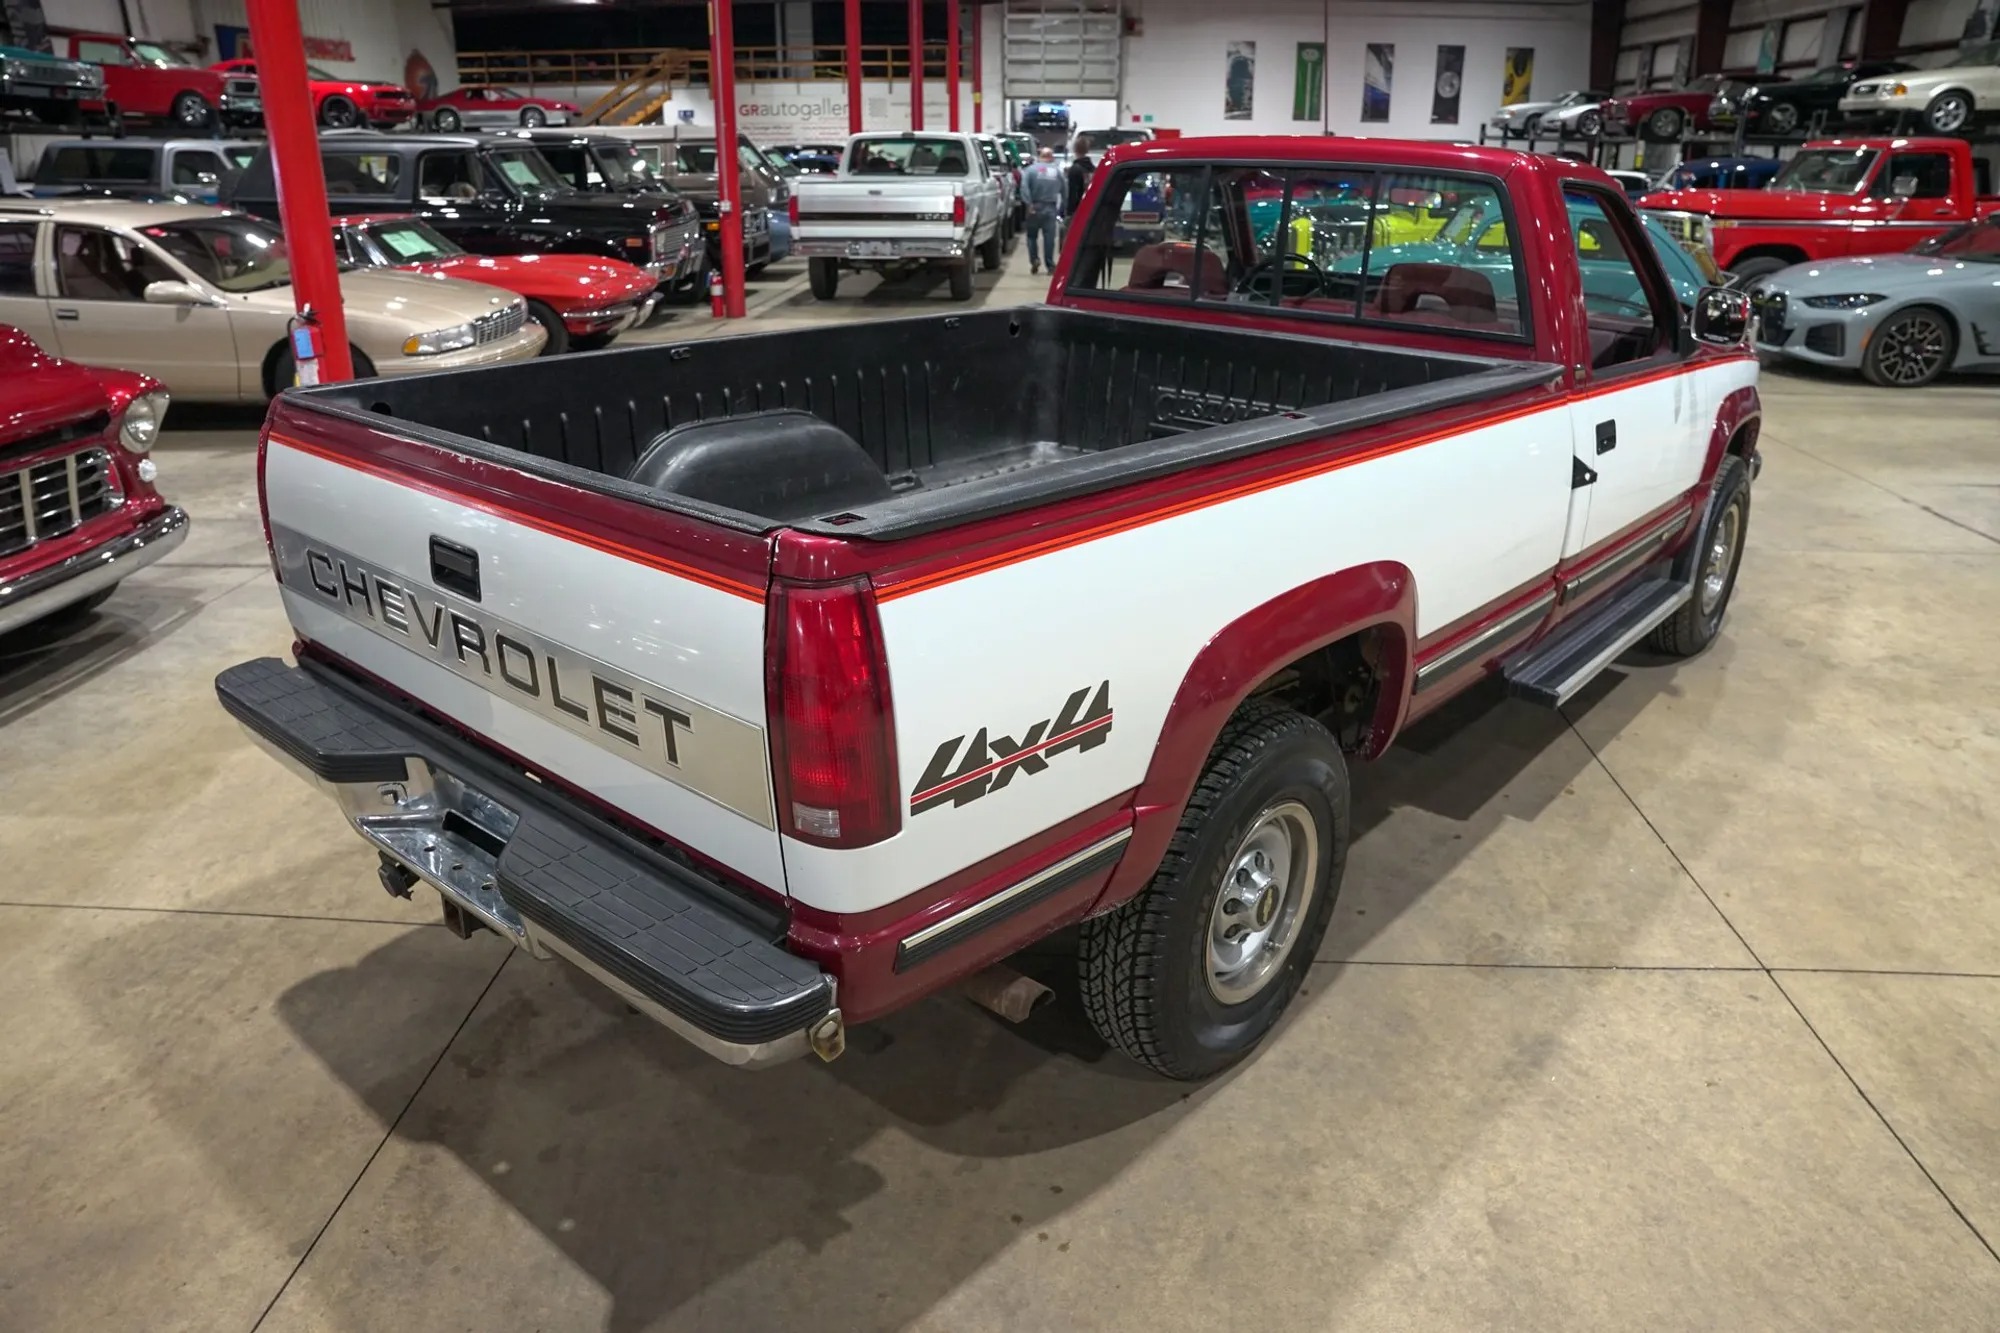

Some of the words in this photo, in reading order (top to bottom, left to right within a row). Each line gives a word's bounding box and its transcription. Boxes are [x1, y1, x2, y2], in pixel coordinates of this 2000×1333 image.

[738, 98, 849, 121] GRautogaller
[305, 547, 693, 768] CHEVROLET
[910, 679, 1113, 817] 4x4
